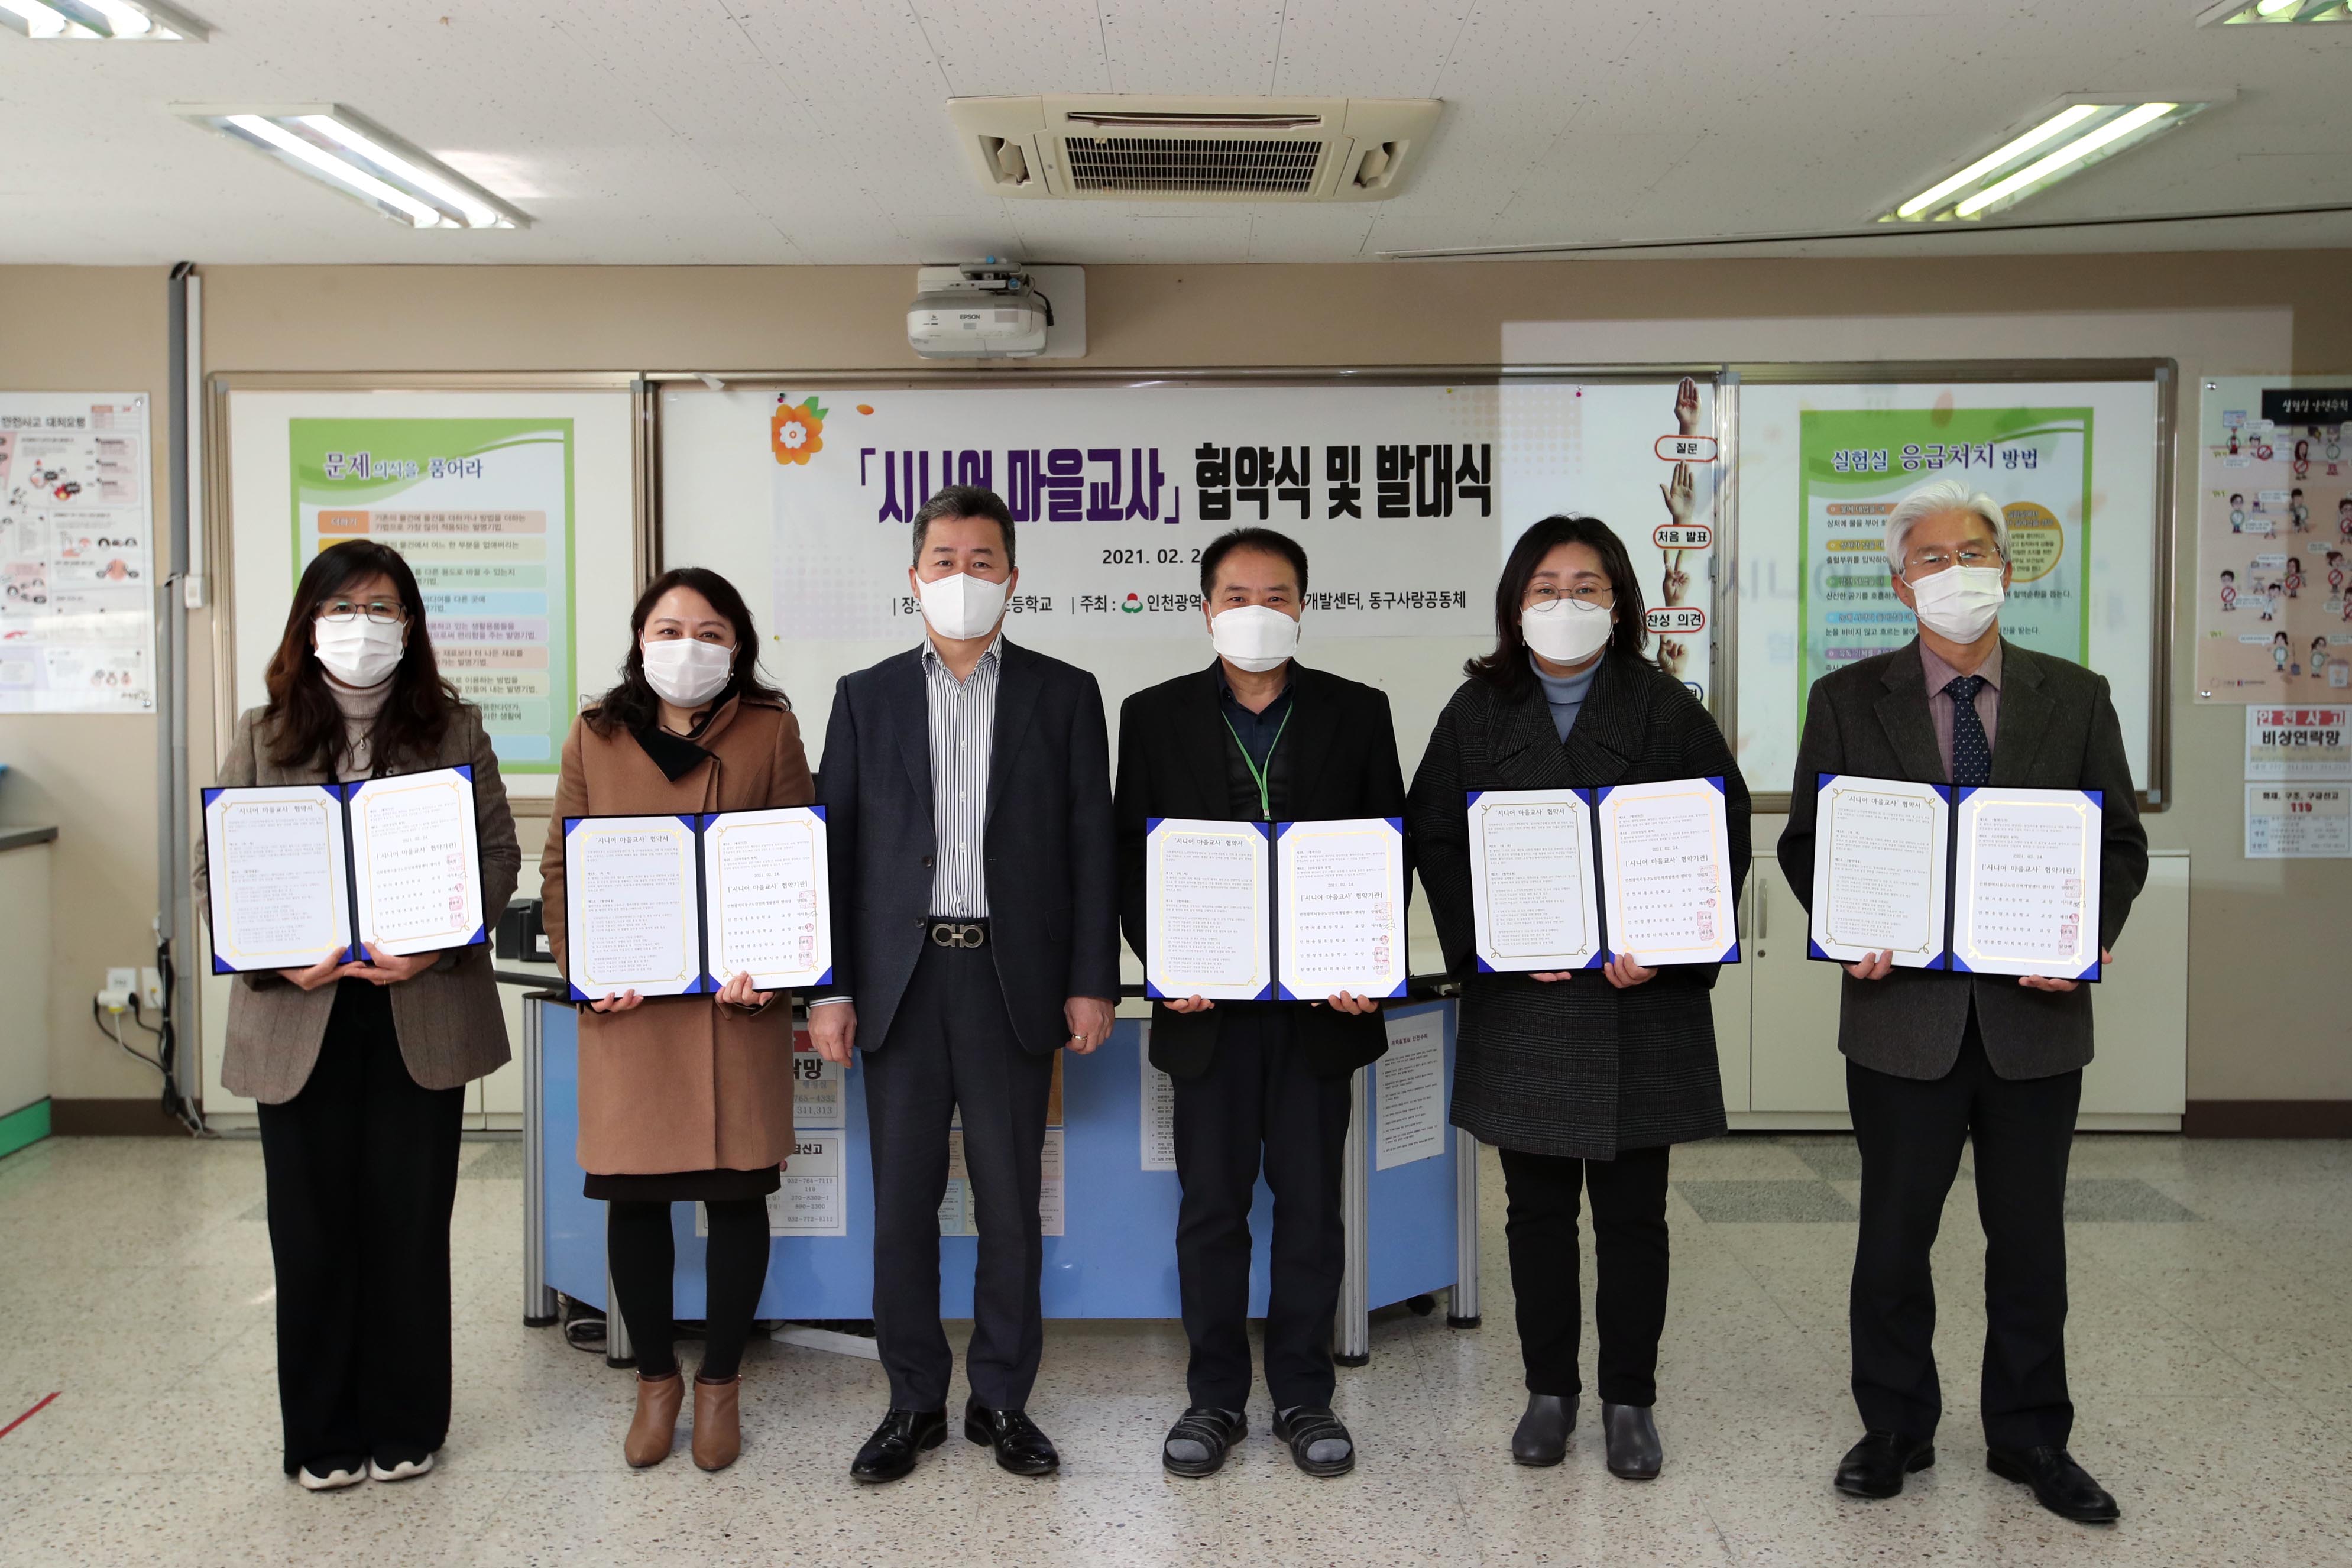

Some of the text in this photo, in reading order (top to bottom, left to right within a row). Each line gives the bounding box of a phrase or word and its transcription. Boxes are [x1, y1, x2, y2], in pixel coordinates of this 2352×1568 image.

[1676, 443, 1698, 455] 질문
[1832, 443, 2037, 471] 실험실 응급처치 방법
[430, 459, 484, 479] 품어라
[1008, 448, 1179, 524] 마을교사」
[1195, 442, 1310, 520] 협약식
[1327, 444, 1362, 519] 및
[1377, 443, 1491, 518] 발대식
[1658, 530, 1708, 543] 처음 발표
[1102, 549, 1201, 564] 2021. 02. 2
[1080, 596, 1107, 613] 주최
[1147, 594, 1202, 611] 인천광역
[1305, 592, 1466, 610] 개발센터, 동구사랑공동체
[1647, 613, 1701, 627] 찬성 의견
[2262, 730, 2340, 746] 비상연락망
[2291, 802, 2312, 813] 119
[650, 834, 669, 843] 협약서
[797, 1106, 832, 1115] 311,313
